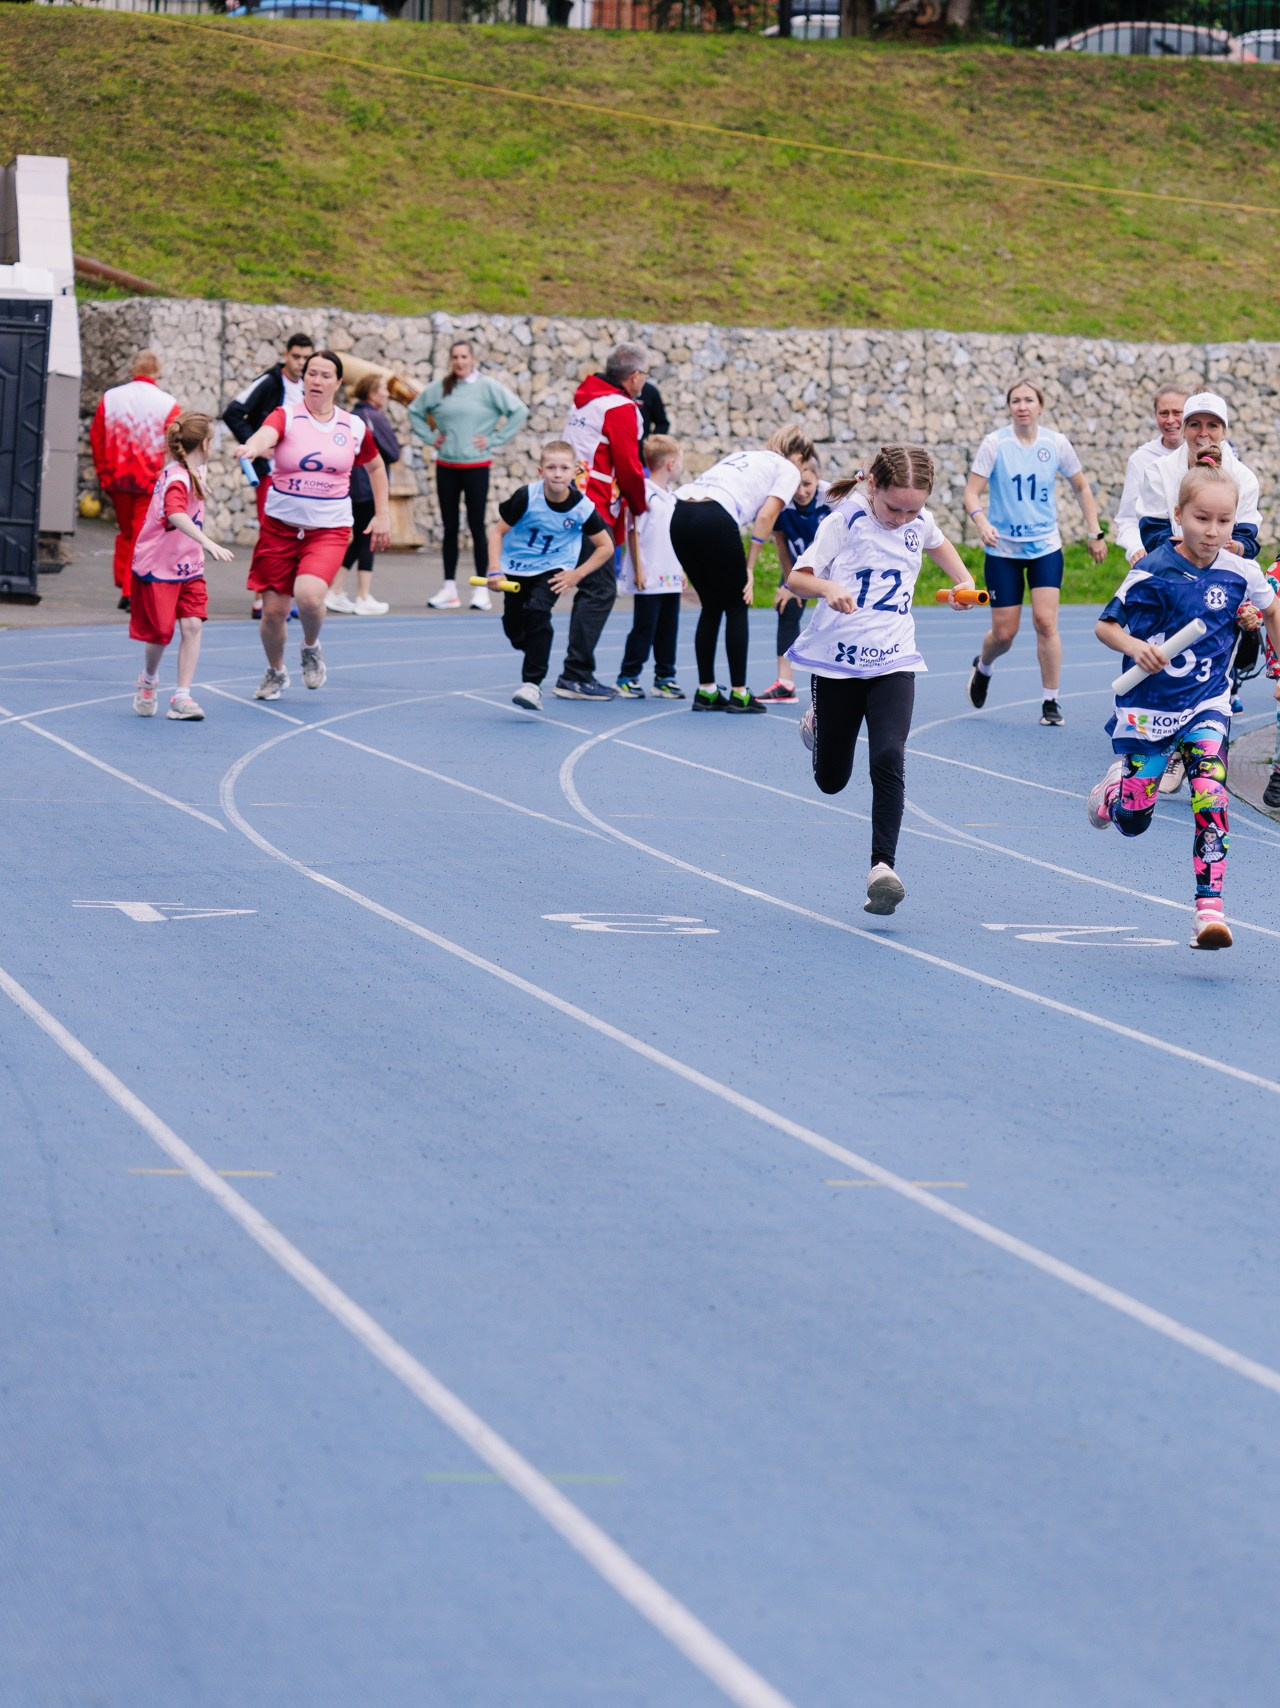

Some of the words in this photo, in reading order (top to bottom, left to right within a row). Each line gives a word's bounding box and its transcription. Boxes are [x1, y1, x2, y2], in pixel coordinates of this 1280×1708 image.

[299, 451, 323, 472] 6
[1011, 474, 1036, 501] 11
[855, 568, 902, 612] 12
[1195, 657, 1213, 683] 3
[71, 899, 260, 922] 4
[540, 912, 721, 935] 3
[980, 923, 1180, 947] 2
